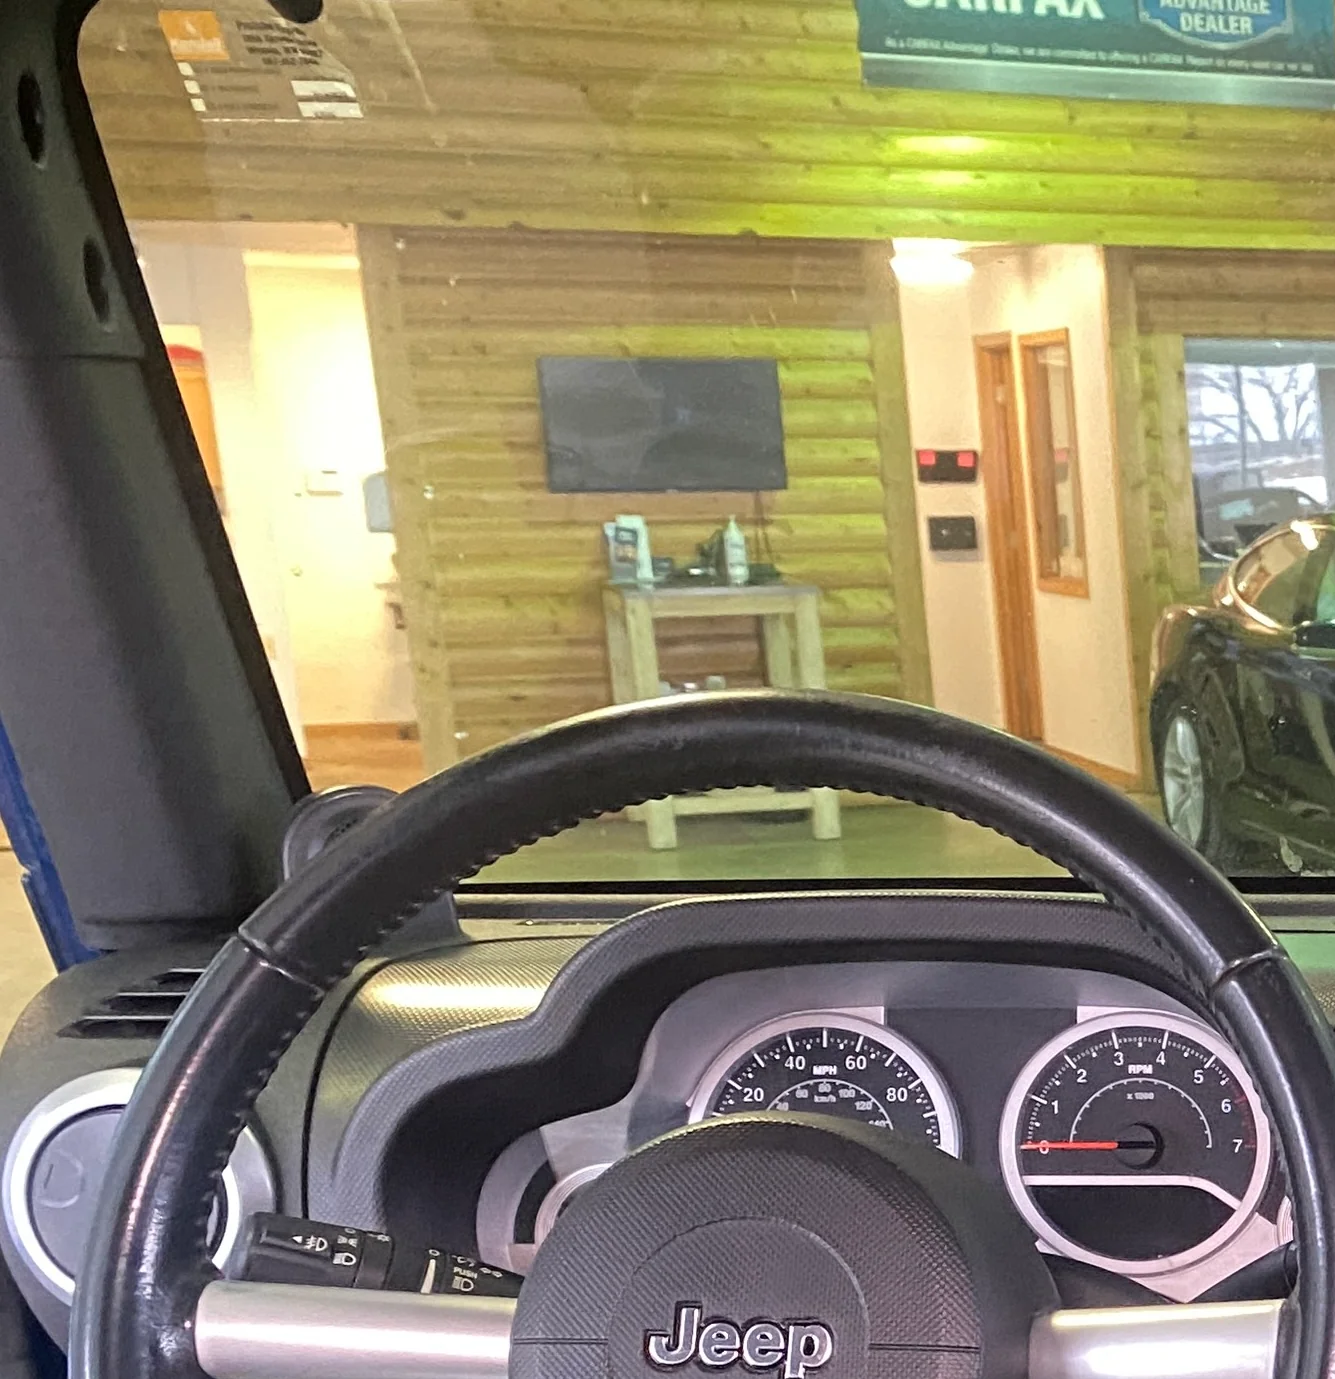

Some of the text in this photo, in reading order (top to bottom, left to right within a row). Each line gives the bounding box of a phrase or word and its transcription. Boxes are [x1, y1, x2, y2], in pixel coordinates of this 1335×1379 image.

[1179, 12, 1253, 35] DEALER
[784, 1055, 806, 1071] 40
[845, 1055, 867, 1070] 60
[1113, 1051, 1124, 1066] 3
[1155, 1051, 1166, 1066] 4
[812, 1065, 838, 1076] MPH
[1076, 1069, 1087, 1084] 2
[1128, 1064, 1154, 1075] RPM
[1193, 1069, 1204, 1085] 5
[743, 1087, 764, 1103] 20
[885, 1087, 908, 1102] 80
[1051, 1099, 1059, 1115] 1
[1220, 1098, 1232, 1113] 6
[1232, 1139, 1244, 1153] 7
[453, 1266, 478, 1280] PUSH
